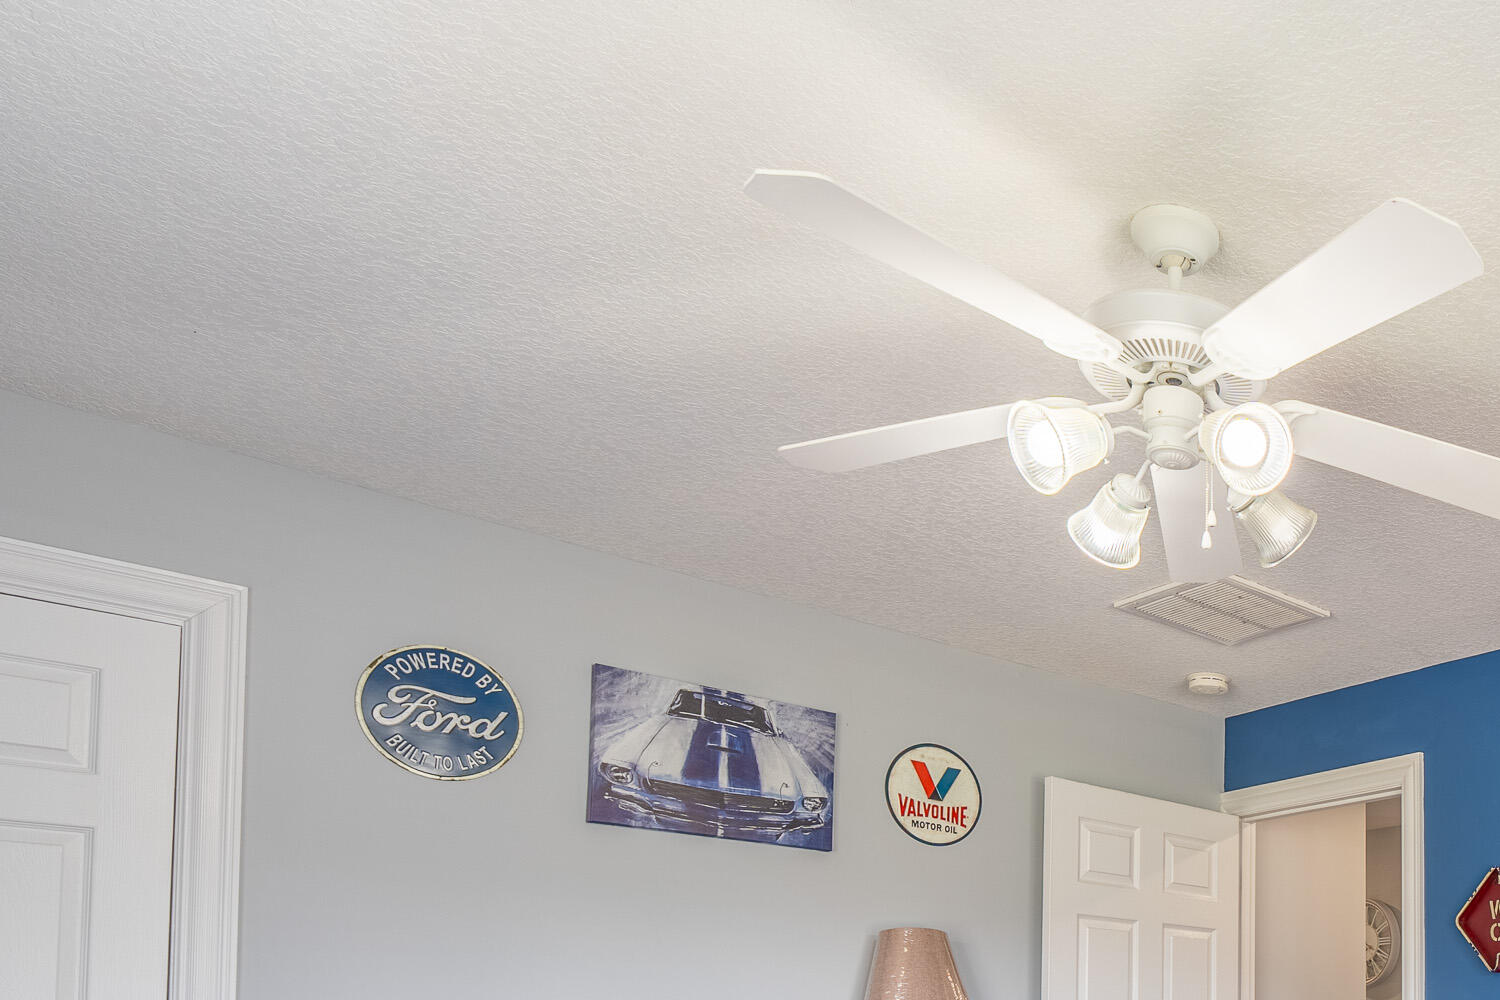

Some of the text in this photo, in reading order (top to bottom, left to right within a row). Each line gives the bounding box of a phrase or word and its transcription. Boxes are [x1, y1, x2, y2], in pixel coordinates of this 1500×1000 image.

[384, 652, 503, 695] POWERED BY
[372, 684, 509, 741] Ford
[386, 733, 494, 771] BUILT TO LAST
[898, 793, 968, 829] VALVOLINE
[911, 819, 958, 834] MOTOR OIL
